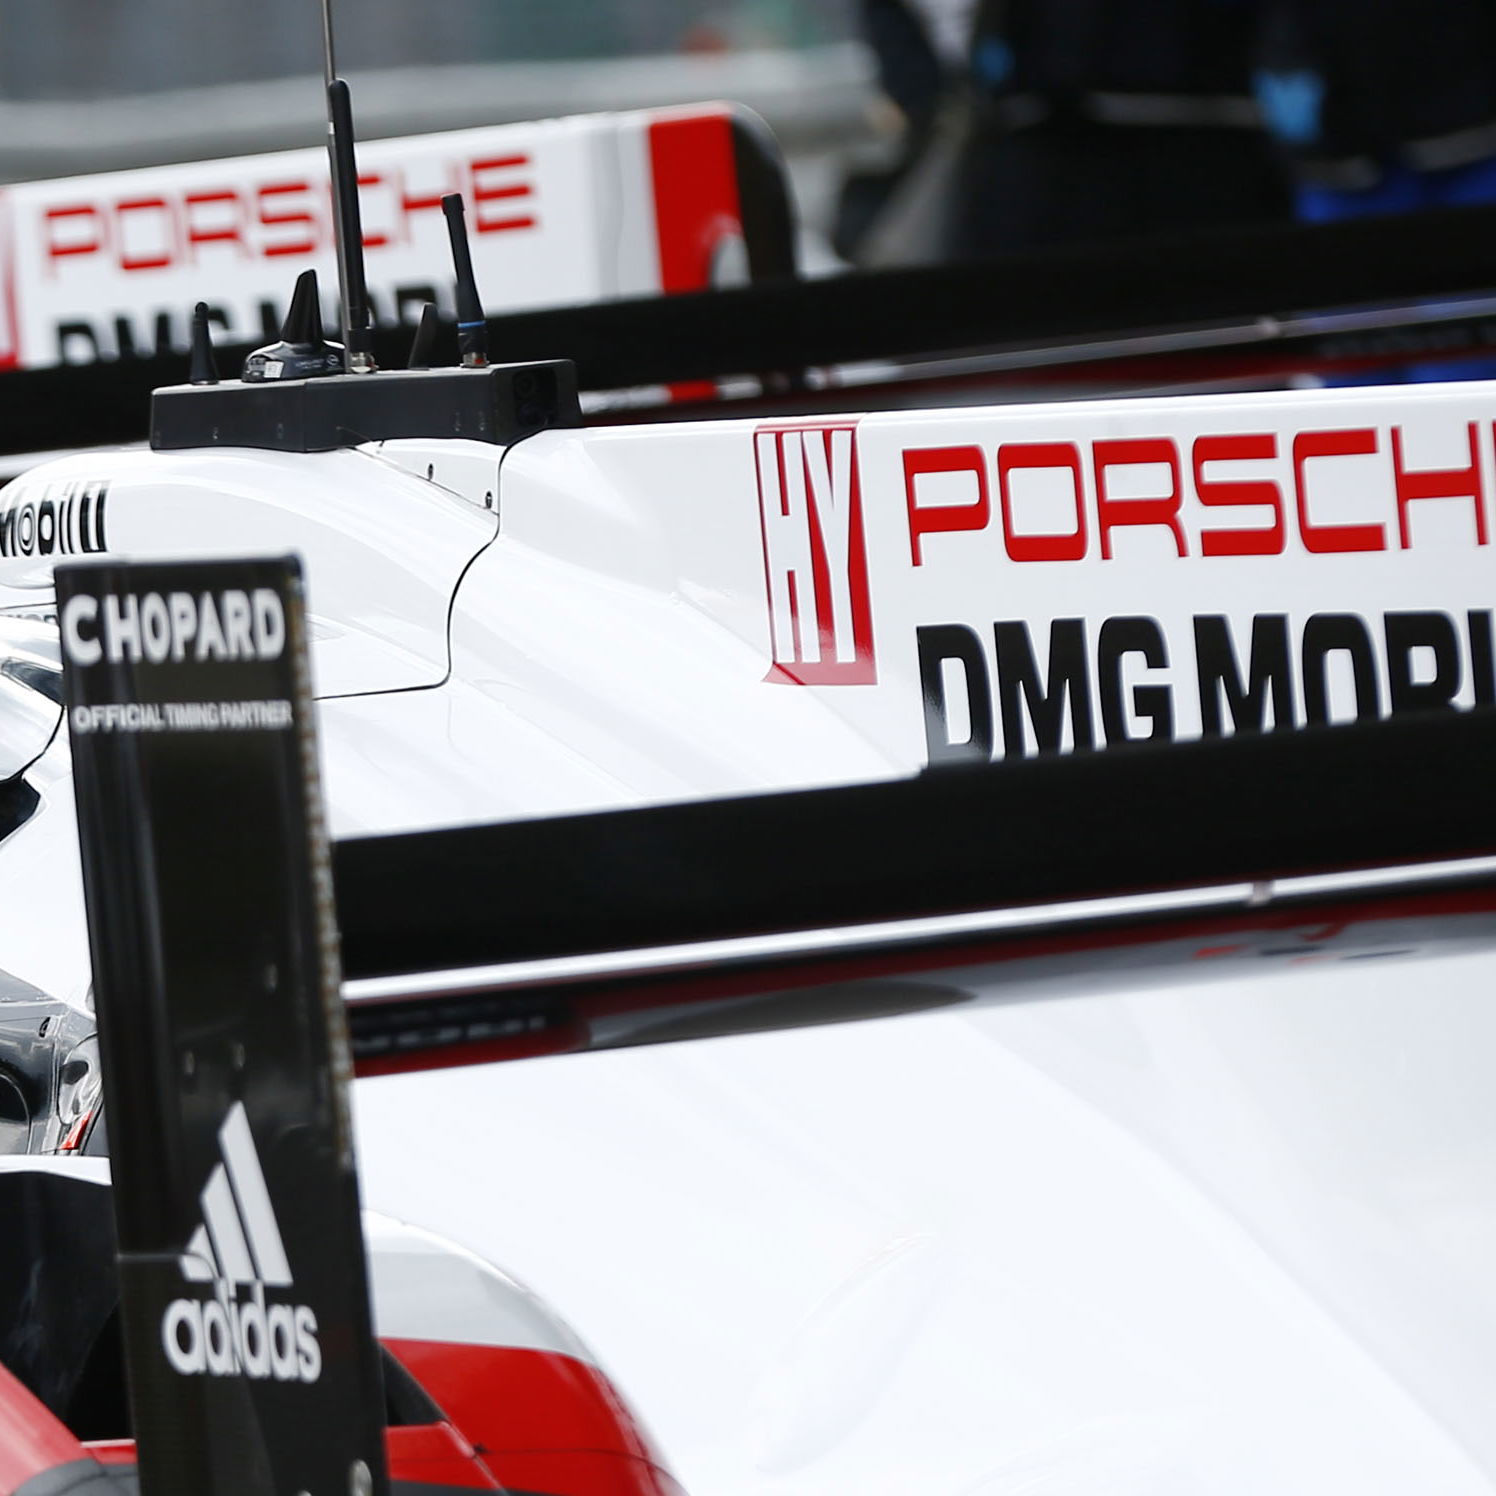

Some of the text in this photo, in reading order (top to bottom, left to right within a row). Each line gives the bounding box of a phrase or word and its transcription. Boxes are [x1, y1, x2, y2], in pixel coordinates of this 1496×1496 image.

[755, 430, 858, 663] HY
[902, 420, 1496, 567] PORSCH
[60, 588, 286, 667] CHOPARD
[915, 614, 1175, 762] DMG
[73, 700, 293, 734] OFFICIAL TIMING PARTNER
[161, 1281, 322, 1383] adidas
